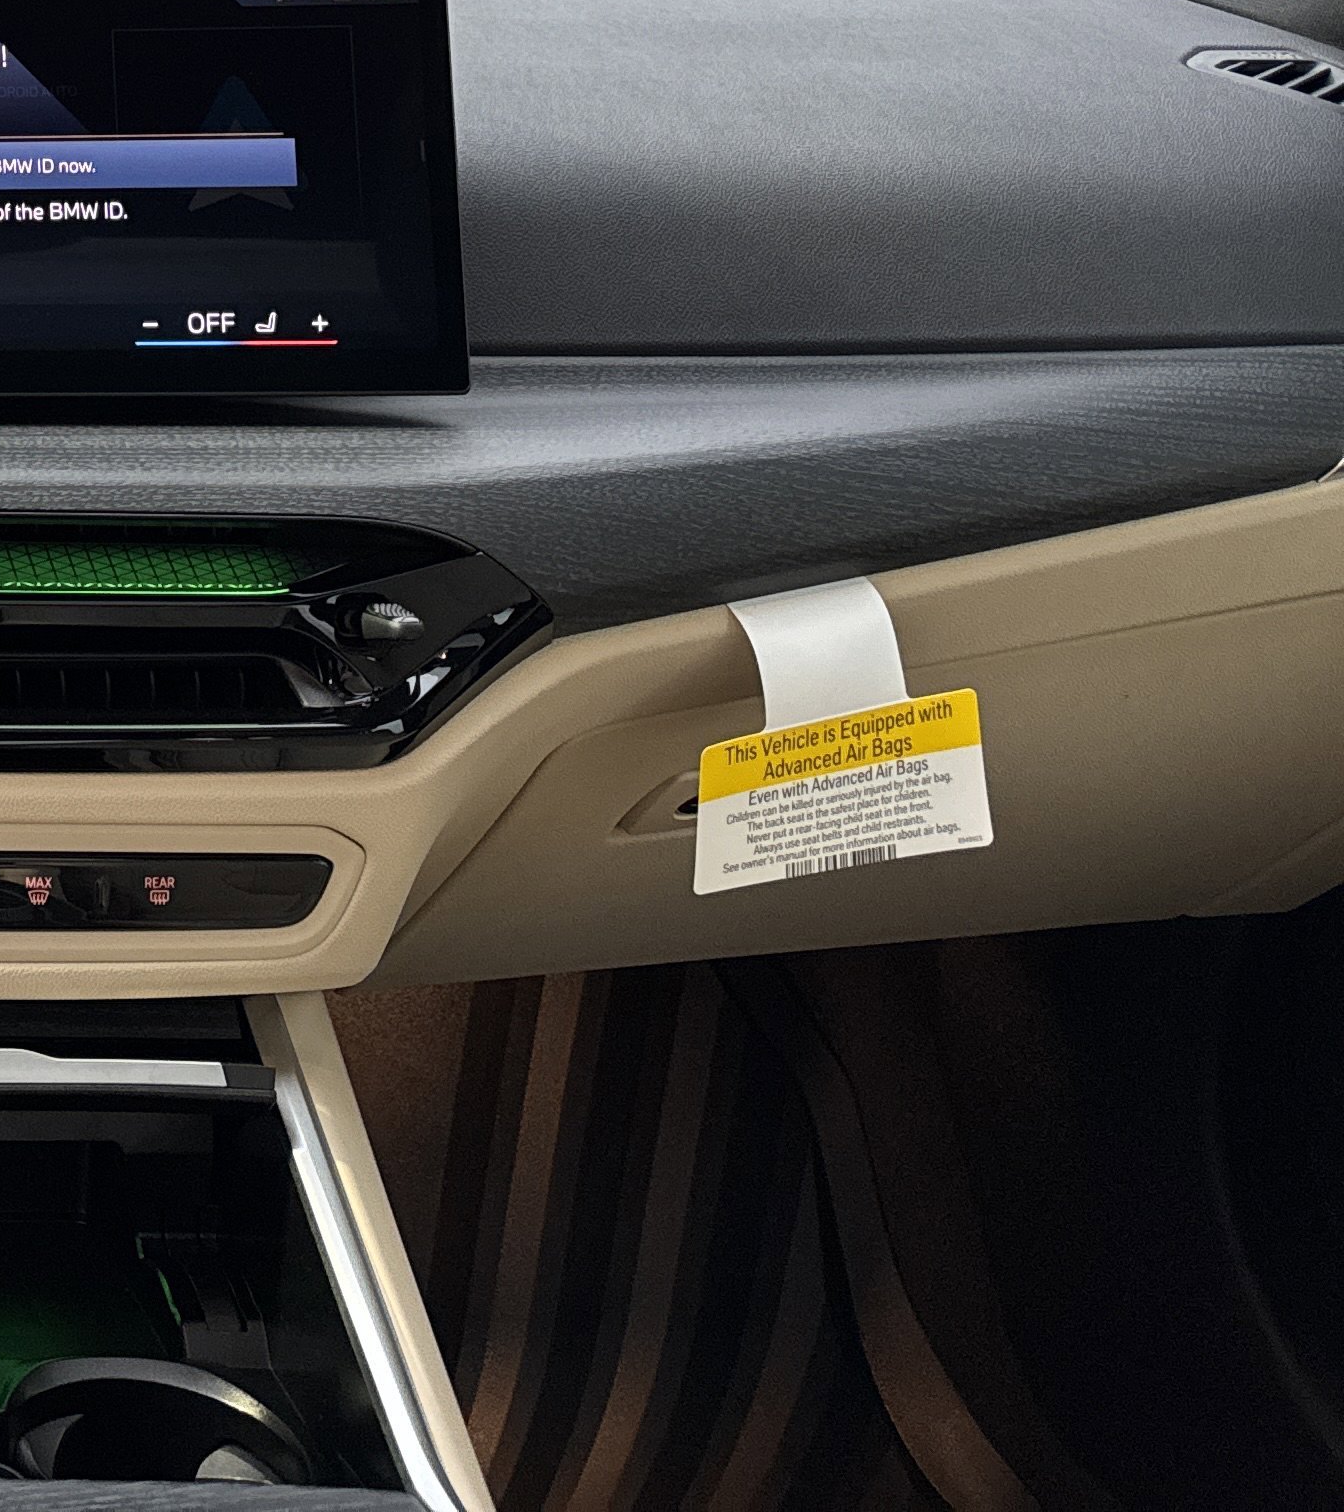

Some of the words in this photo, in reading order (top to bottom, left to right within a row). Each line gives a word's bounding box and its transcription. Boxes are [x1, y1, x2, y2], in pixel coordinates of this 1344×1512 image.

[38, 158, 54, 174] ID
[59, 160, 96, 174] now.
[15, 203, 44, 221] the
[49, 202, 98, 220] BMW
[104, 202, 128, 220] ID.
[187, 312, 236, 335] OFF
[724, 745, 757, 765] This
[762, 727, 819, 756] Vehicle
[824, 724, 836, 738] is
[841, 706, 914, 739] Equipped
[918, 699, 953, 723] with
[762, 745, 842, 781] Advanced
[846, 742, 869, 763] Air
[873, 736, 913, 760] Bags
[726, 809, 760, 825] Children
[762, 806, 777, 817] can
[779, 802, 789, 813] be
[792, 797, 813, 810] killed
[816, 797, 824, 806] or
[825, 787, 862, 805] seriously
[864, 781, 892, 798] injured
[894, 780, 904, 792] by
[906, 777, 919, 788] the
[921, 774, 932, 784] air
[933, 772, 953, 785] bag.
[749, 786, 779, 806] Even
[782, 779, 809, 798] with
[812, 766, 873, 793] Advanced
[876, 763, 893, 780] Air
[896, 758, 929, 778] Bags
[747, 821, 763, 832] The
[765, 815, 785, 828] back
[787, 812, 805, 824] seat
[806, 811, 813, 820] is
[815, 808, 829, 819] the
[831, 801, 855, 815] safest
[857, 798, 879, 812] place
[881, 795, 892, 806] for
[894, 789, 932, 803] children.
[747, 832, 771, 844] Never
[773, 828, 787, 841] put
[796, 818, 842, 835] rear-facing
[843, 813, 863, 826] child
[865, 810, 882, 821] seat
[884, 806, 892, 817] in
[894, 804, 908, 816] the
[910, 800, 933, 813] front.
[722, 862, 740, 874] See
[741, 854, 774, 870] owner's
[776, 847, 807, 863] manual
[809, 846, 820, 857] for
[822, 841, 845, 853] more
[846, 832, 895, 849] information
[896, 827, 922, 840] about
[923, 825, 935, 836] air
[936, 822, 961, 835] bags.
[753, 841, 783, 856] Always
[784, 838, 800, 849] use
[802, 834, 820, 846] seat
[822, 829, 842, 841] belts
[844, 825, 859, 838] and
[861, 821, 881, 834] child
[883, 814, 927, 830] restraints.
[25, 876, 52, 889] MAX
[144, 876, 175, 889] REAR
